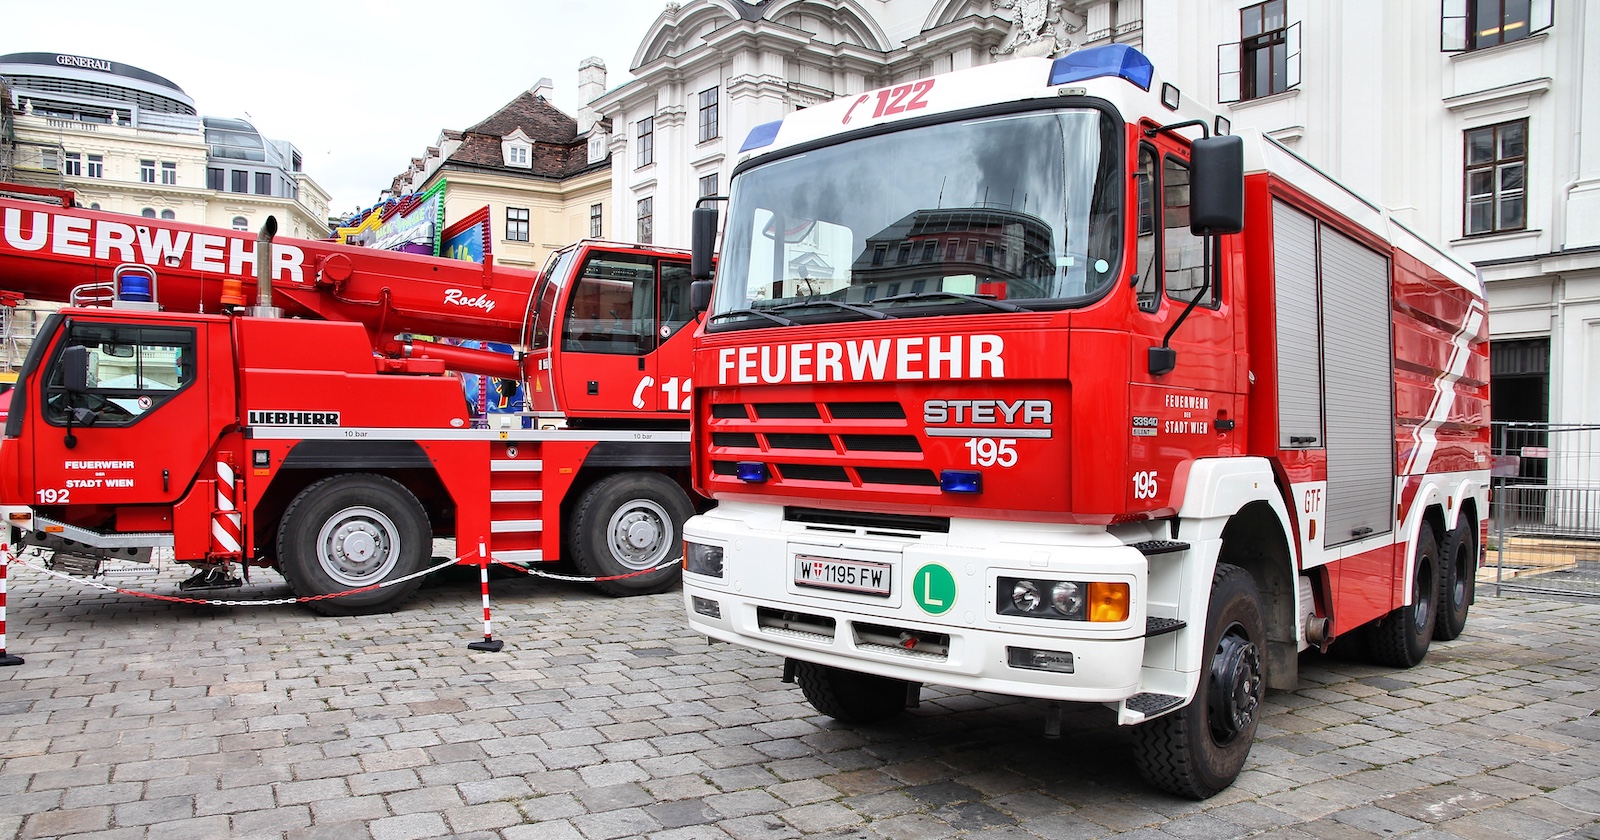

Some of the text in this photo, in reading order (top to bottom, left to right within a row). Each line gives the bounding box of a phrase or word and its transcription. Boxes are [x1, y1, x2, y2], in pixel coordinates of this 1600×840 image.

[56, 54, 112, 71] GENERALI
[872, 79, 936, 118] 122
[444, 289, 496, 313] Rocky
[718, 334, 1006, 385] FEUERWEHR
[923, 399, 1053, 425] STEYR
[1165, 394, 1209, 409] FEUERWEHR
[249, 411, 339, 425] LIEBHERR
[1165, 421, 1208, 434] STADT WIEN
[642, 432, 652, 440] bar
[65, 460, 135, 469] FEUERWEHR
[965, 437, 1018, 468] 195
[66, 479, 134, 488] STADT WIEN
[1132, 470, 1158, 499] 195
[36, 488, 70, 504] 192
[1305, 489, 1321, 514] GTF
[801, 561, 883, 588] W 1195 FW
[924, 571, 944, 607] L
